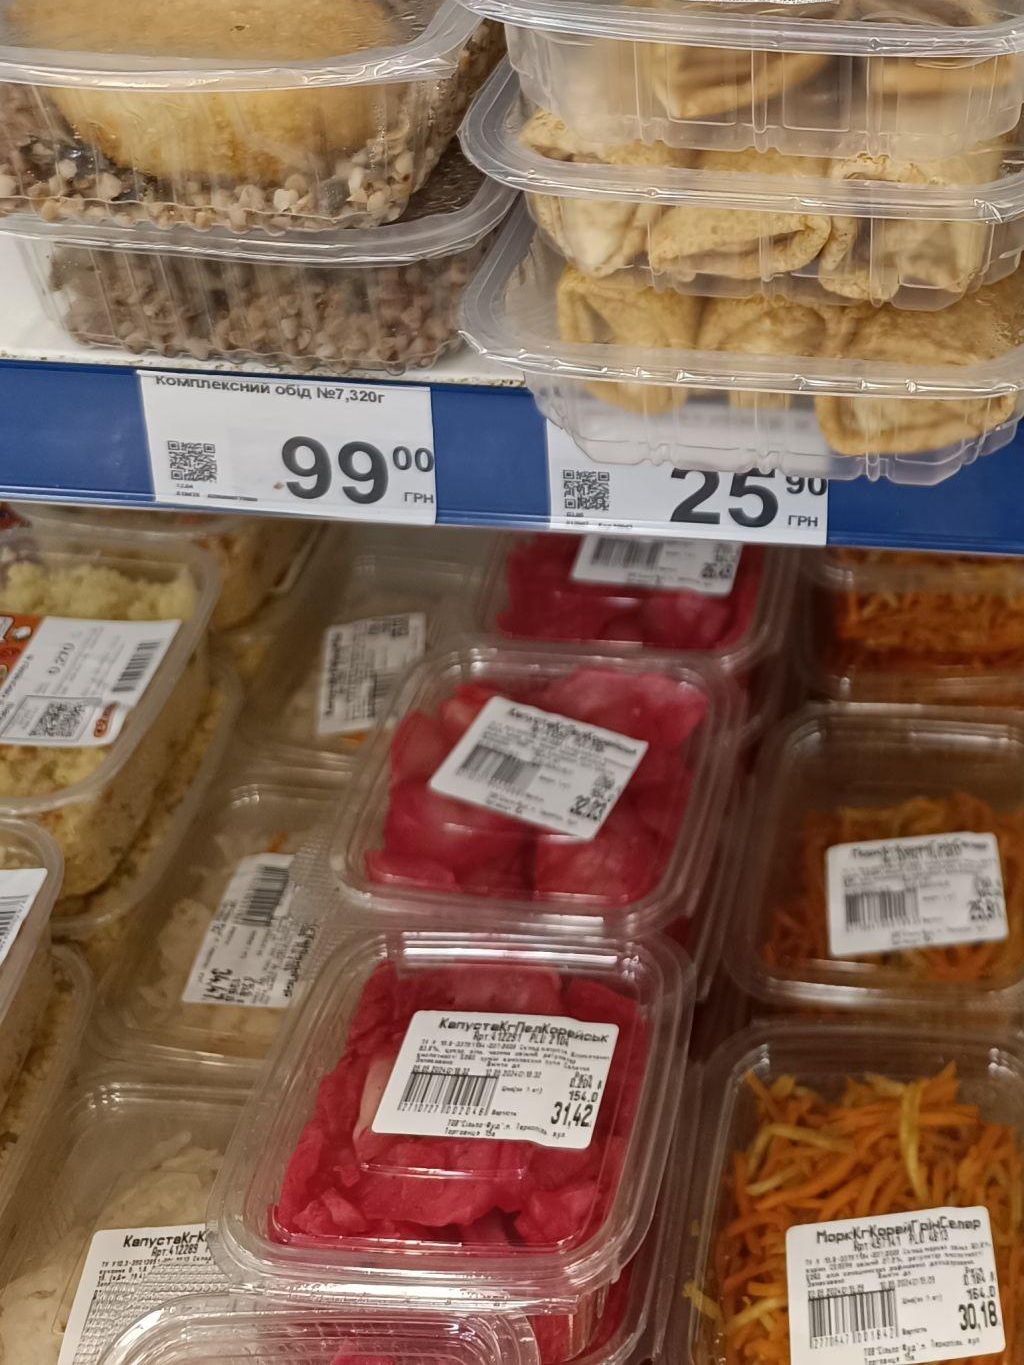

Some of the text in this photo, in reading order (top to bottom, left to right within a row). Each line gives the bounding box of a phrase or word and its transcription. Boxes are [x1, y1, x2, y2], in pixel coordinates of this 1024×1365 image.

[156, 375, 385, 404] Комплексний обід №7,320г
[281, 435, 435, 505] 99 00
[404, 490, 435, 504] ГРН
[670, 466, 779, 528] 25
[788, 514, 819, 528] ГРН
[958, 1300, 998, 1331] 30,18
